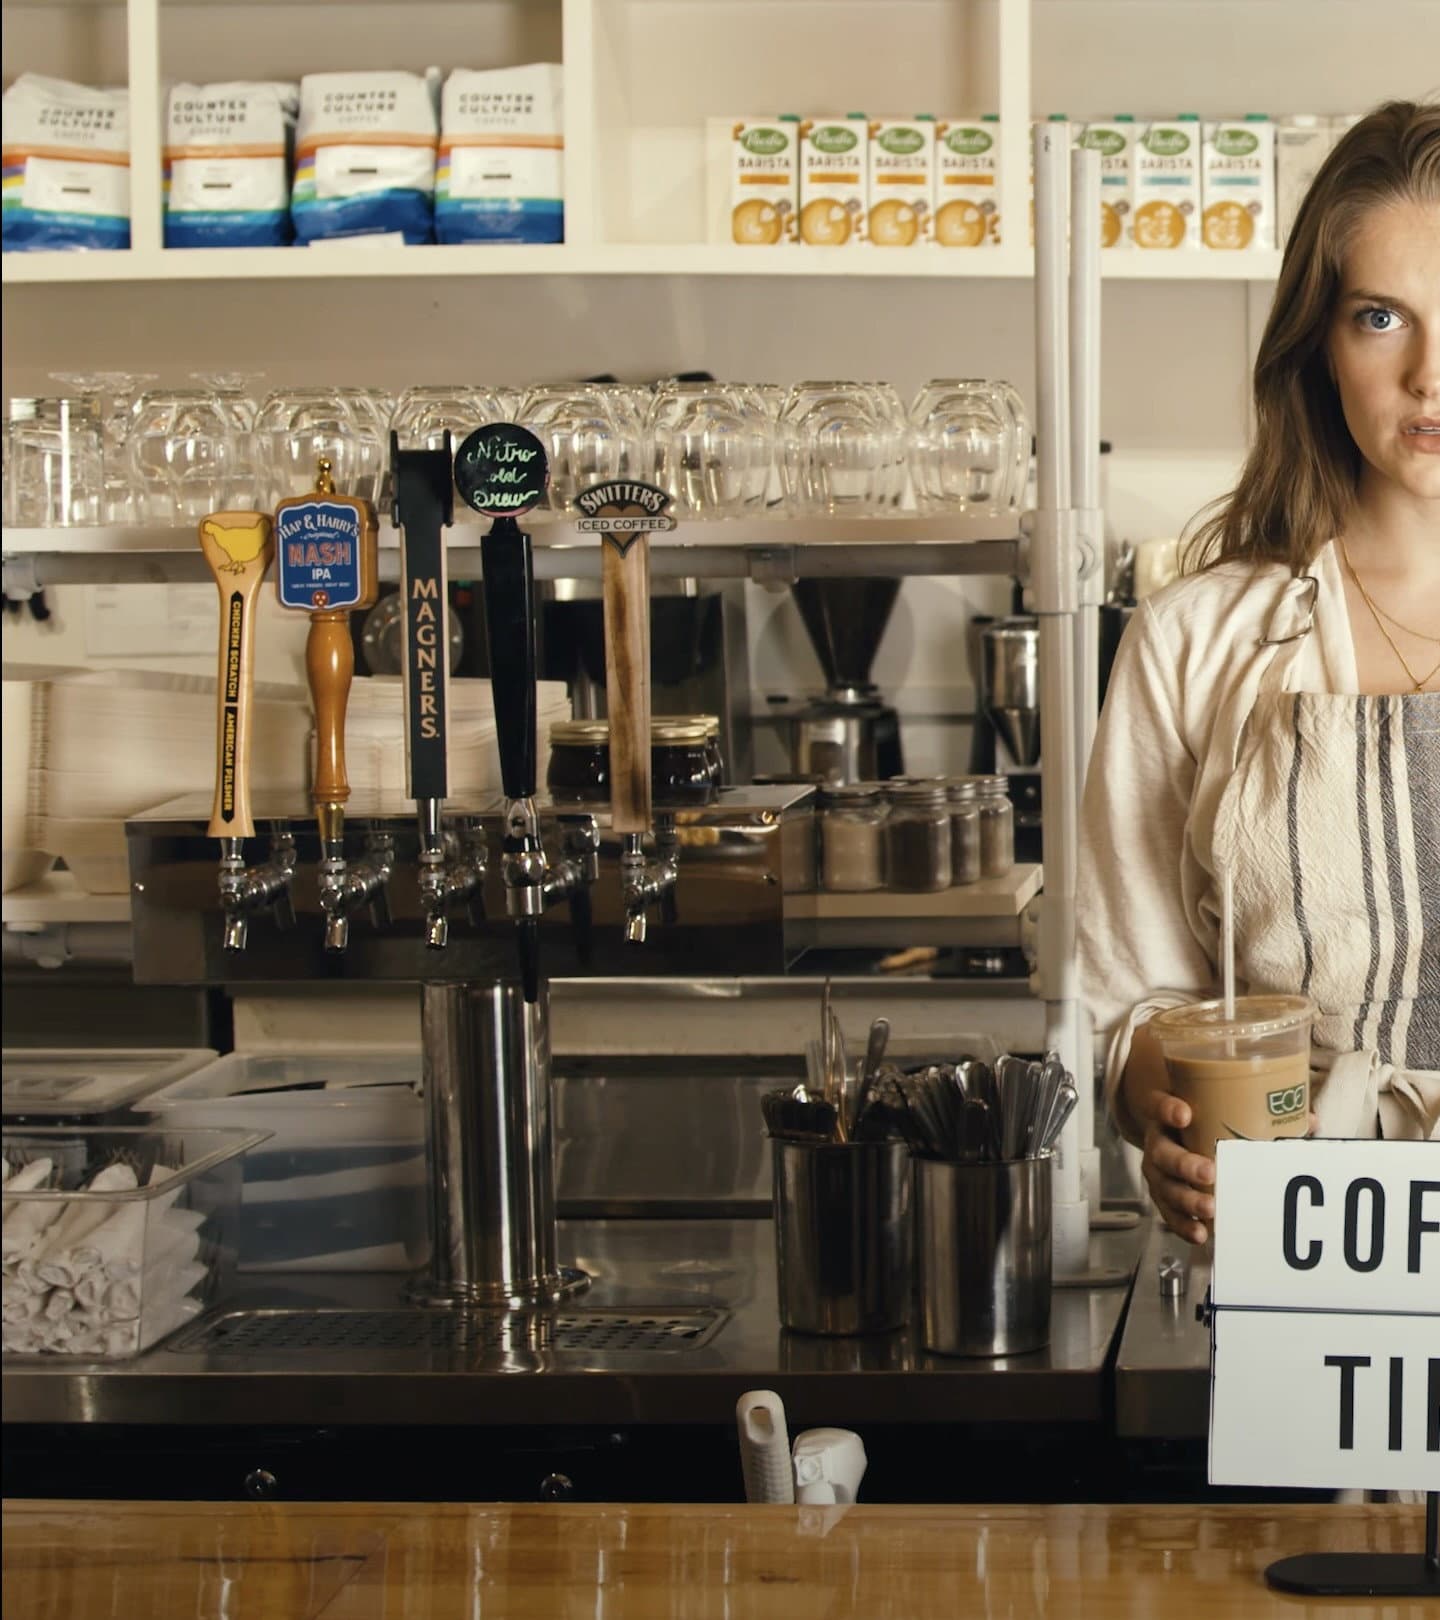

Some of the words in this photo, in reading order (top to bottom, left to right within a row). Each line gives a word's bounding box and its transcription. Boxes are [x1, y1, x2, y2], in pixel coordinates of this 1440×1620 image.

[325, 91, 398, 101] COUNTER
[459, 94, 534, 103] COUNTER
[173, 101, 248, 111] COUNTER
[324, 102, 396, 113] CULTURE
[459, 104, 534, 114] CULTURE
[39, 117, 113, 130] CULTURE
[173, 113, 247, 123] CULTURE
[467, 435, 537, 462] Nitro
[579, 482, 665, 515] SWITTERS
[279, 519, 302, 540] HAP
[303, 513, 318, 531] &
[316, 513, 360, 538] HARRY'S
[577, 519, 610, 531] ICED
[613, 518, 667, 530] COFFEE
[287, 540, 352, 567] NASH
[311, 567, 332, 581] IPA
[231, 601, 242, 648] CHICKEN
[227, 651, 241, 699] SCRATCH
[225, 713, 236, 767] AMERICAN
[223, 768, 234, 811] PILSNER
